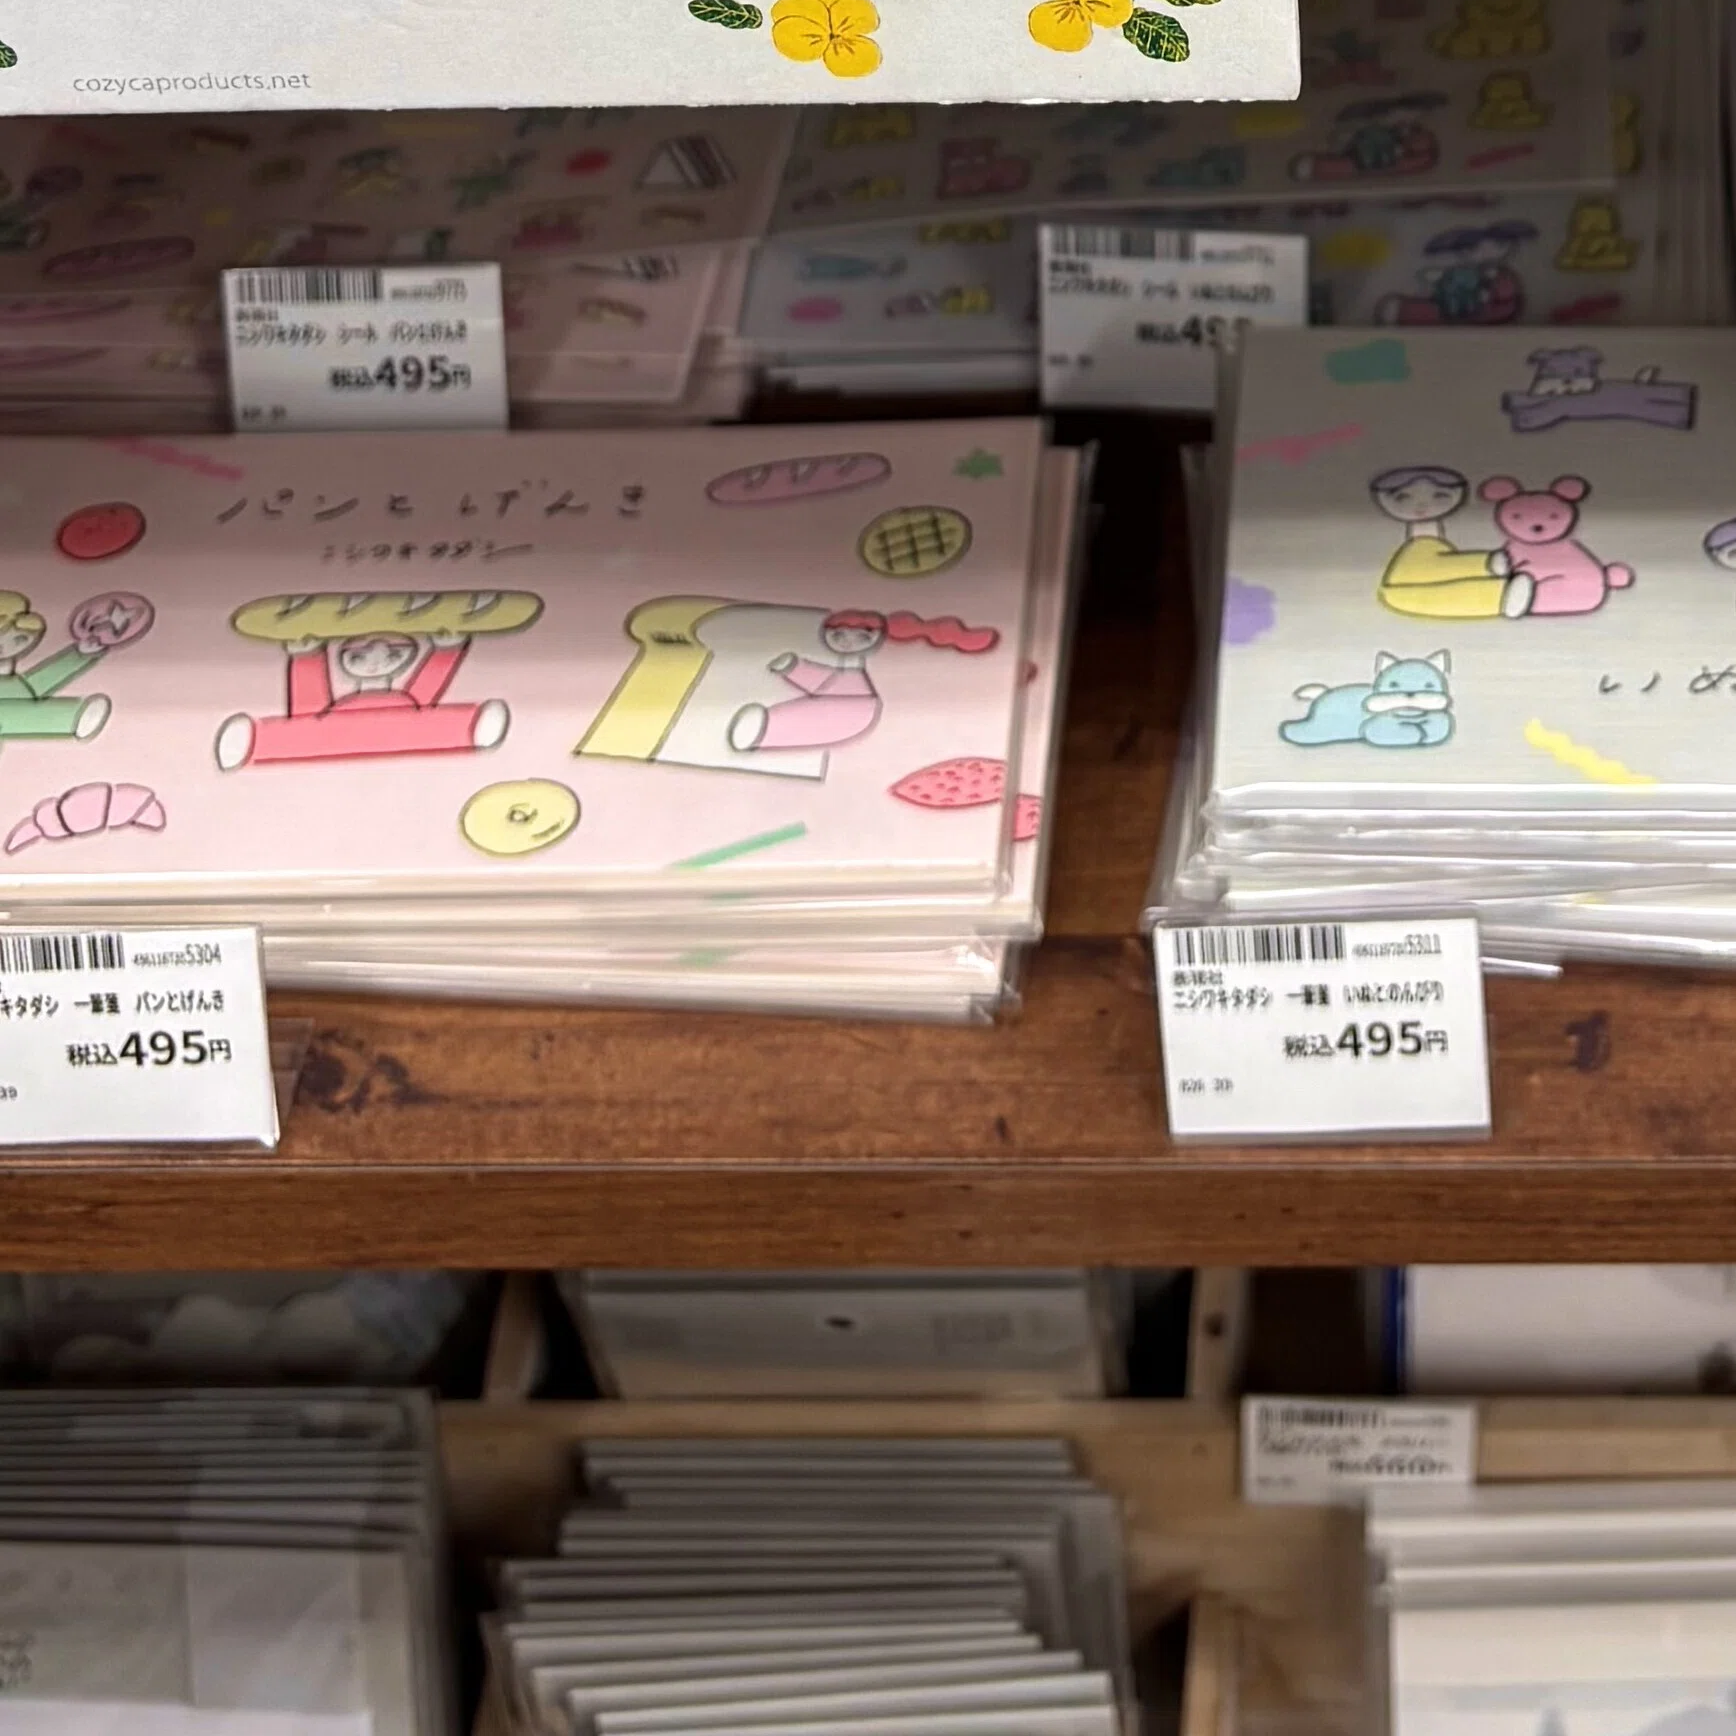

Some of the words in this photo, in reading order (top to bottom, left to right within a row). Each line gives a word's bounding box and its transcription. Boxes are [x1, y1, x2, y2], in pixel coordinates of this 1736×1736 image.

[73, 72, 313, 96] cozycaproducts.net
[65, 1030, 233, 1067] 税込495円
[1282, 1020, 1450, 1058] 税込495円
